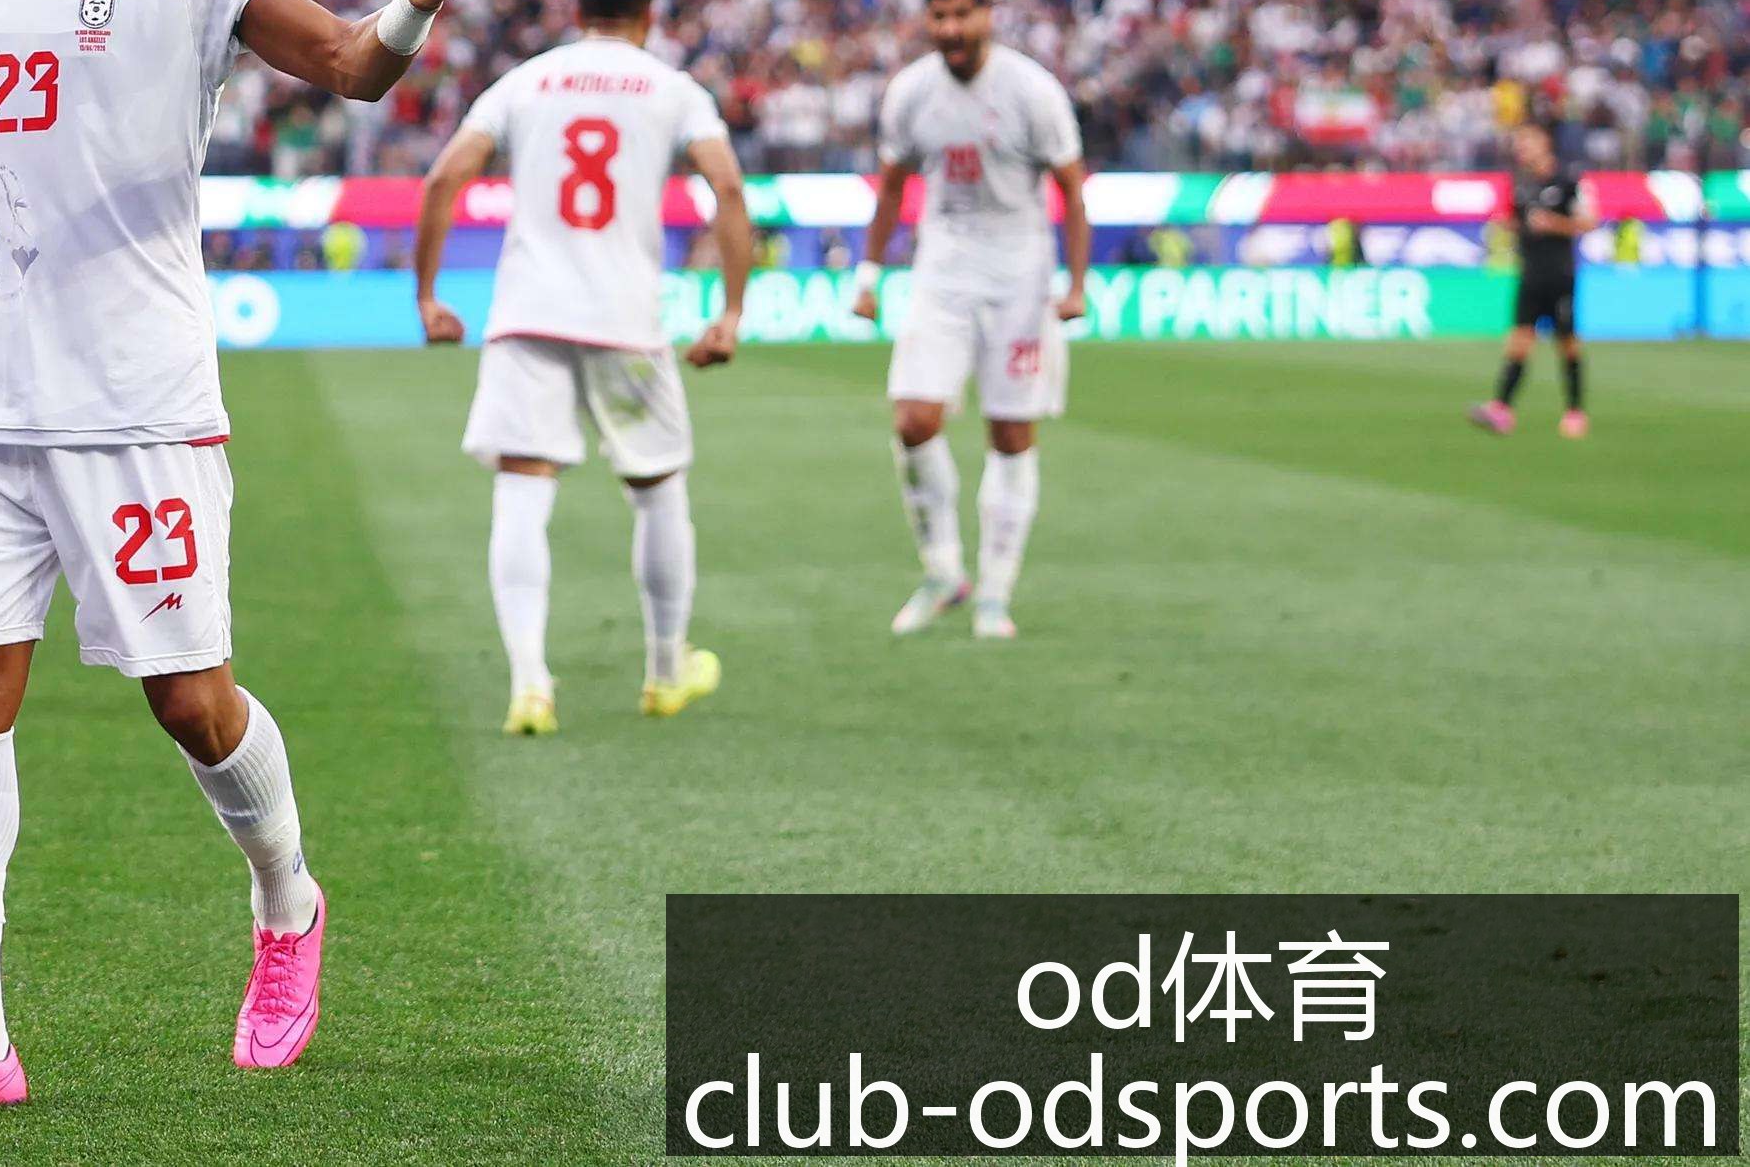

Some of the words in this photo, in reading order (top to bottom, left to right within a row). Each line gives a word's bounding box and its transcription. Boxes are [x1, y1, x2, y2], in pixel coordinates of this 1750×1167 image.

[559, 118, 619, 231] 8
[1139, 267, 1433, 342] PARTNER
[112, 497, 198, 585] 23
